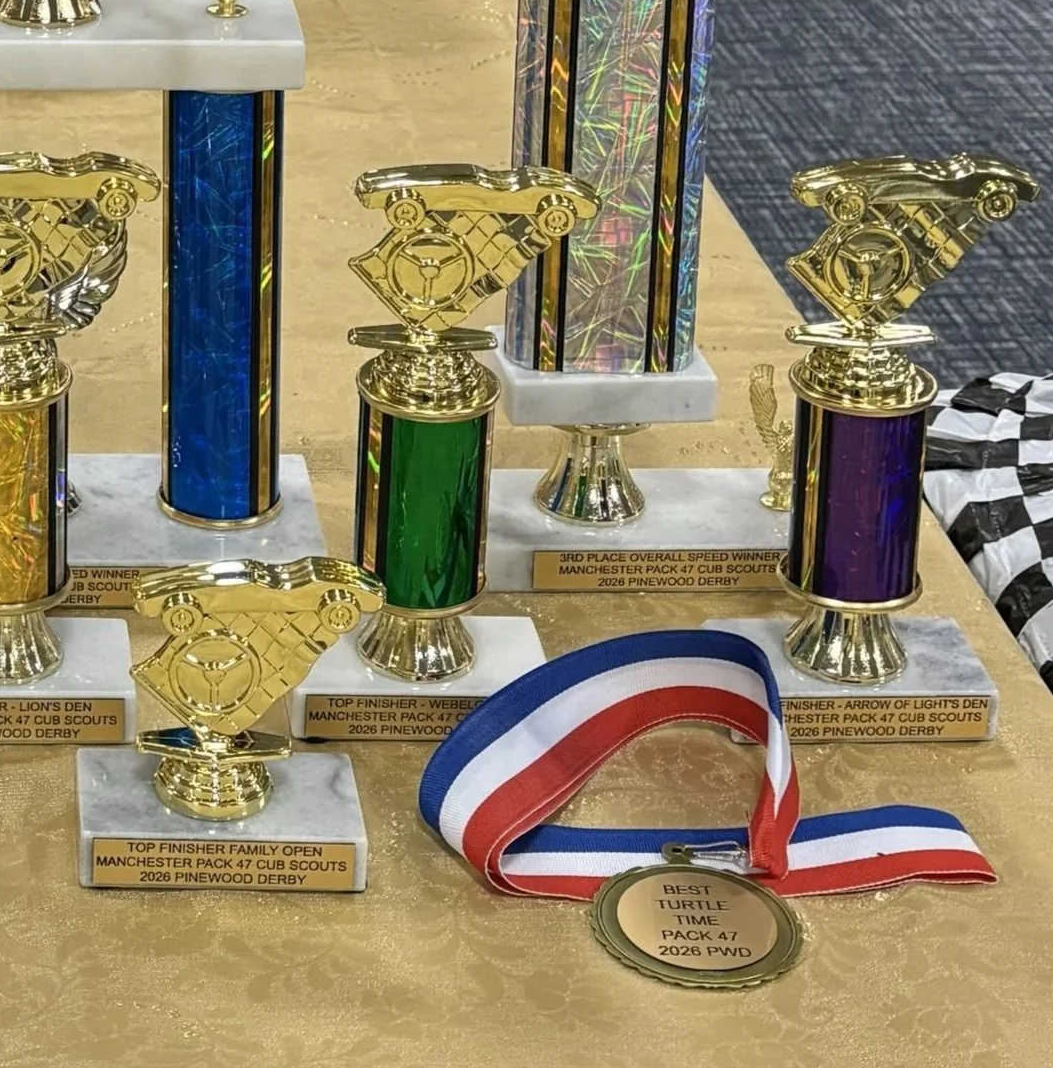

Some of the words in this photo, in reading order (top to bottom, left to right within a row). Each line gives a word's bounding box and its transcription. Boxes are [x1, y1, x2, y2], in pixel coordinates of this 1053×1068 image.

[559, 552, 584, 563] 3RD
[587, 552, 627, 563] PLACE
[630, 552, 684, 562] OVERALL
[688, 552, 729, 562] SPEED
[731, 551, 781, 562] WINNER
[91, 569, 140, 579] WINNER
[559, 565, 643, 575] MANCHESTER
[646, 564, 678, 575] PACK
[680, 564, 694, 574] 47
[698, 564, 722, 574] CUB
[726, 564, 776, 574] SCOUTS
[88, 582, 132, 592] SCOUT
[597, 577, 625, 587] 2026
[628, 576, 695, 587] PINEWOOD
[698, 576, 741, 587] DERBY
[19, 701, 61, 712] LION'S
[64, 701, 92, 712] DEN
[327, 698, 354, 709] TOP
[357, 698, 417, 709] FINISHER
[844, 699, 894, 710] ARROW
[897, 699, 910, 709] OF
[914, 699, 960, 709] LIGHT'S
[963, 699, 988, 709] DEN
[15, 715, 30, 725] 47
[34, 715, 60, 725] CUB
[64, 715, 117, 726] SCOUTS
[308, 711, 397, 722] MANCHESTER
[400, 712, 435, 722] PACK
[437, 712, 451, 721] 47
[843, 713, 877, 723] PACK
[879, 713, 894, 723] 47
[898, 713, 925, 723] CUB
[929, 712, 982, 722] SCOUTS
[35, 728, 81, 739] DERBY
[348, 724, 377, 735] 2026
[380, 724, 453, 735] PINEWOOD
[791, 726, 819, 737] 2026
[823, 726, 896, 737] PINEWOOD
[899, 725, 945, 736] DERBY
[127, 842, 155, 853] TOP
[159, 843, 225, 854] FINISHER
[229, 844, 279, 856] FAMILY
[282, 845, 323, 857] OPEN
[96, 856, 192, 869] MANCHESTER
[196, 858, 232, 870] PACK
[236, 859, 252, 870] 47
[256, 859, 285, 870] CUB
[289, 860, 347, 872] SCOUTS
[139, 872, 171, 883] 2026
[175, 872, 253, 884] PINEWOOD
[257, 873, 306, 885] DERBY
[663, 885, 711, 895] BEST
[655, 899, 730, 911] TURTLE
[673, 915, 721, 926] TIME
[661, 930, 714, 941] PACK
[718, 931, 738, 942] 47
[658, 945, 701, 956] 2026
[707, 947, 751, 958] PWD
